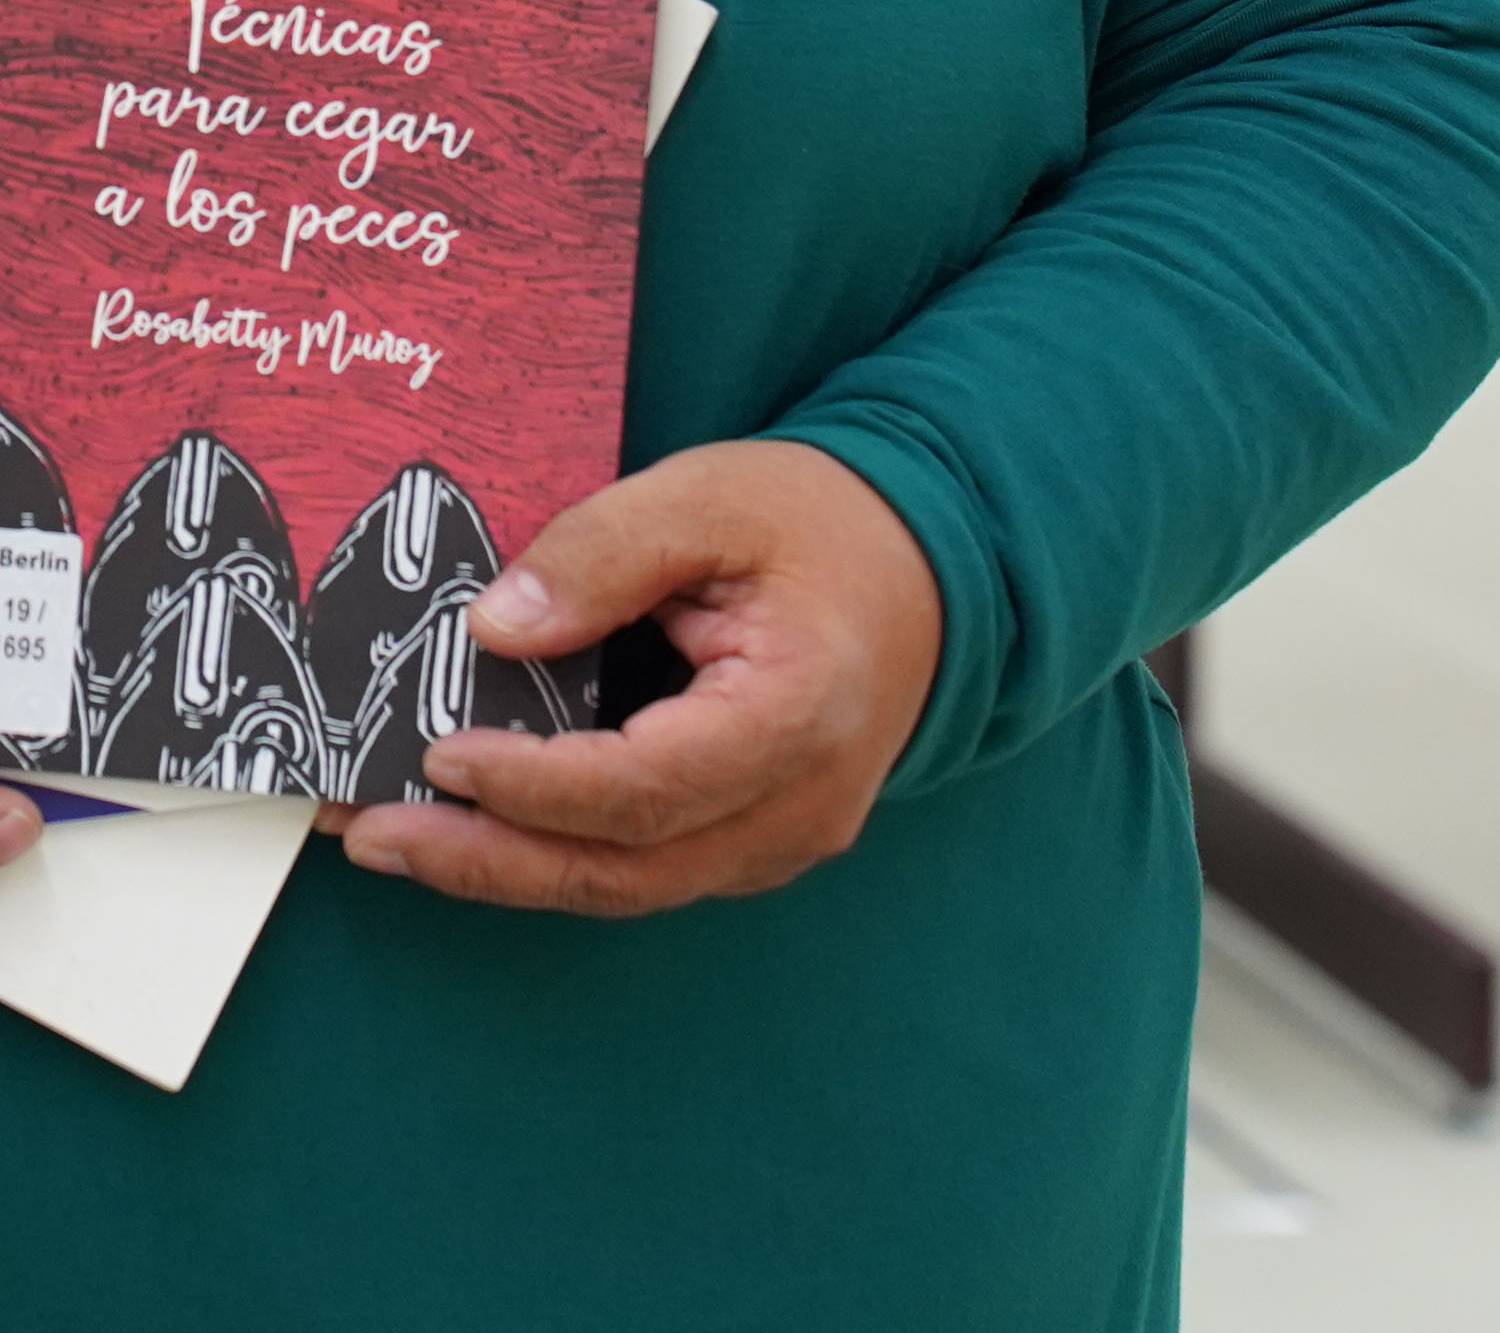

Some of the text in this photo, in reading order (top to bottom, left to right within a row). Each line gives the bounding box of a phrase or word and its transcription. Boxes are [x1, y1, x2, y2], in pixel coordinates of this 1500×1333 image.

[96, 81, 474, 190] para cegar
[94, 148, 460, 272] a los peces
[91, 287, 443, 390] Rosabetty Muñoz
[0, 547, 69, 571] Berlin
[6, 598, 30, 622] 19
[37, 599, 47, 623] /
